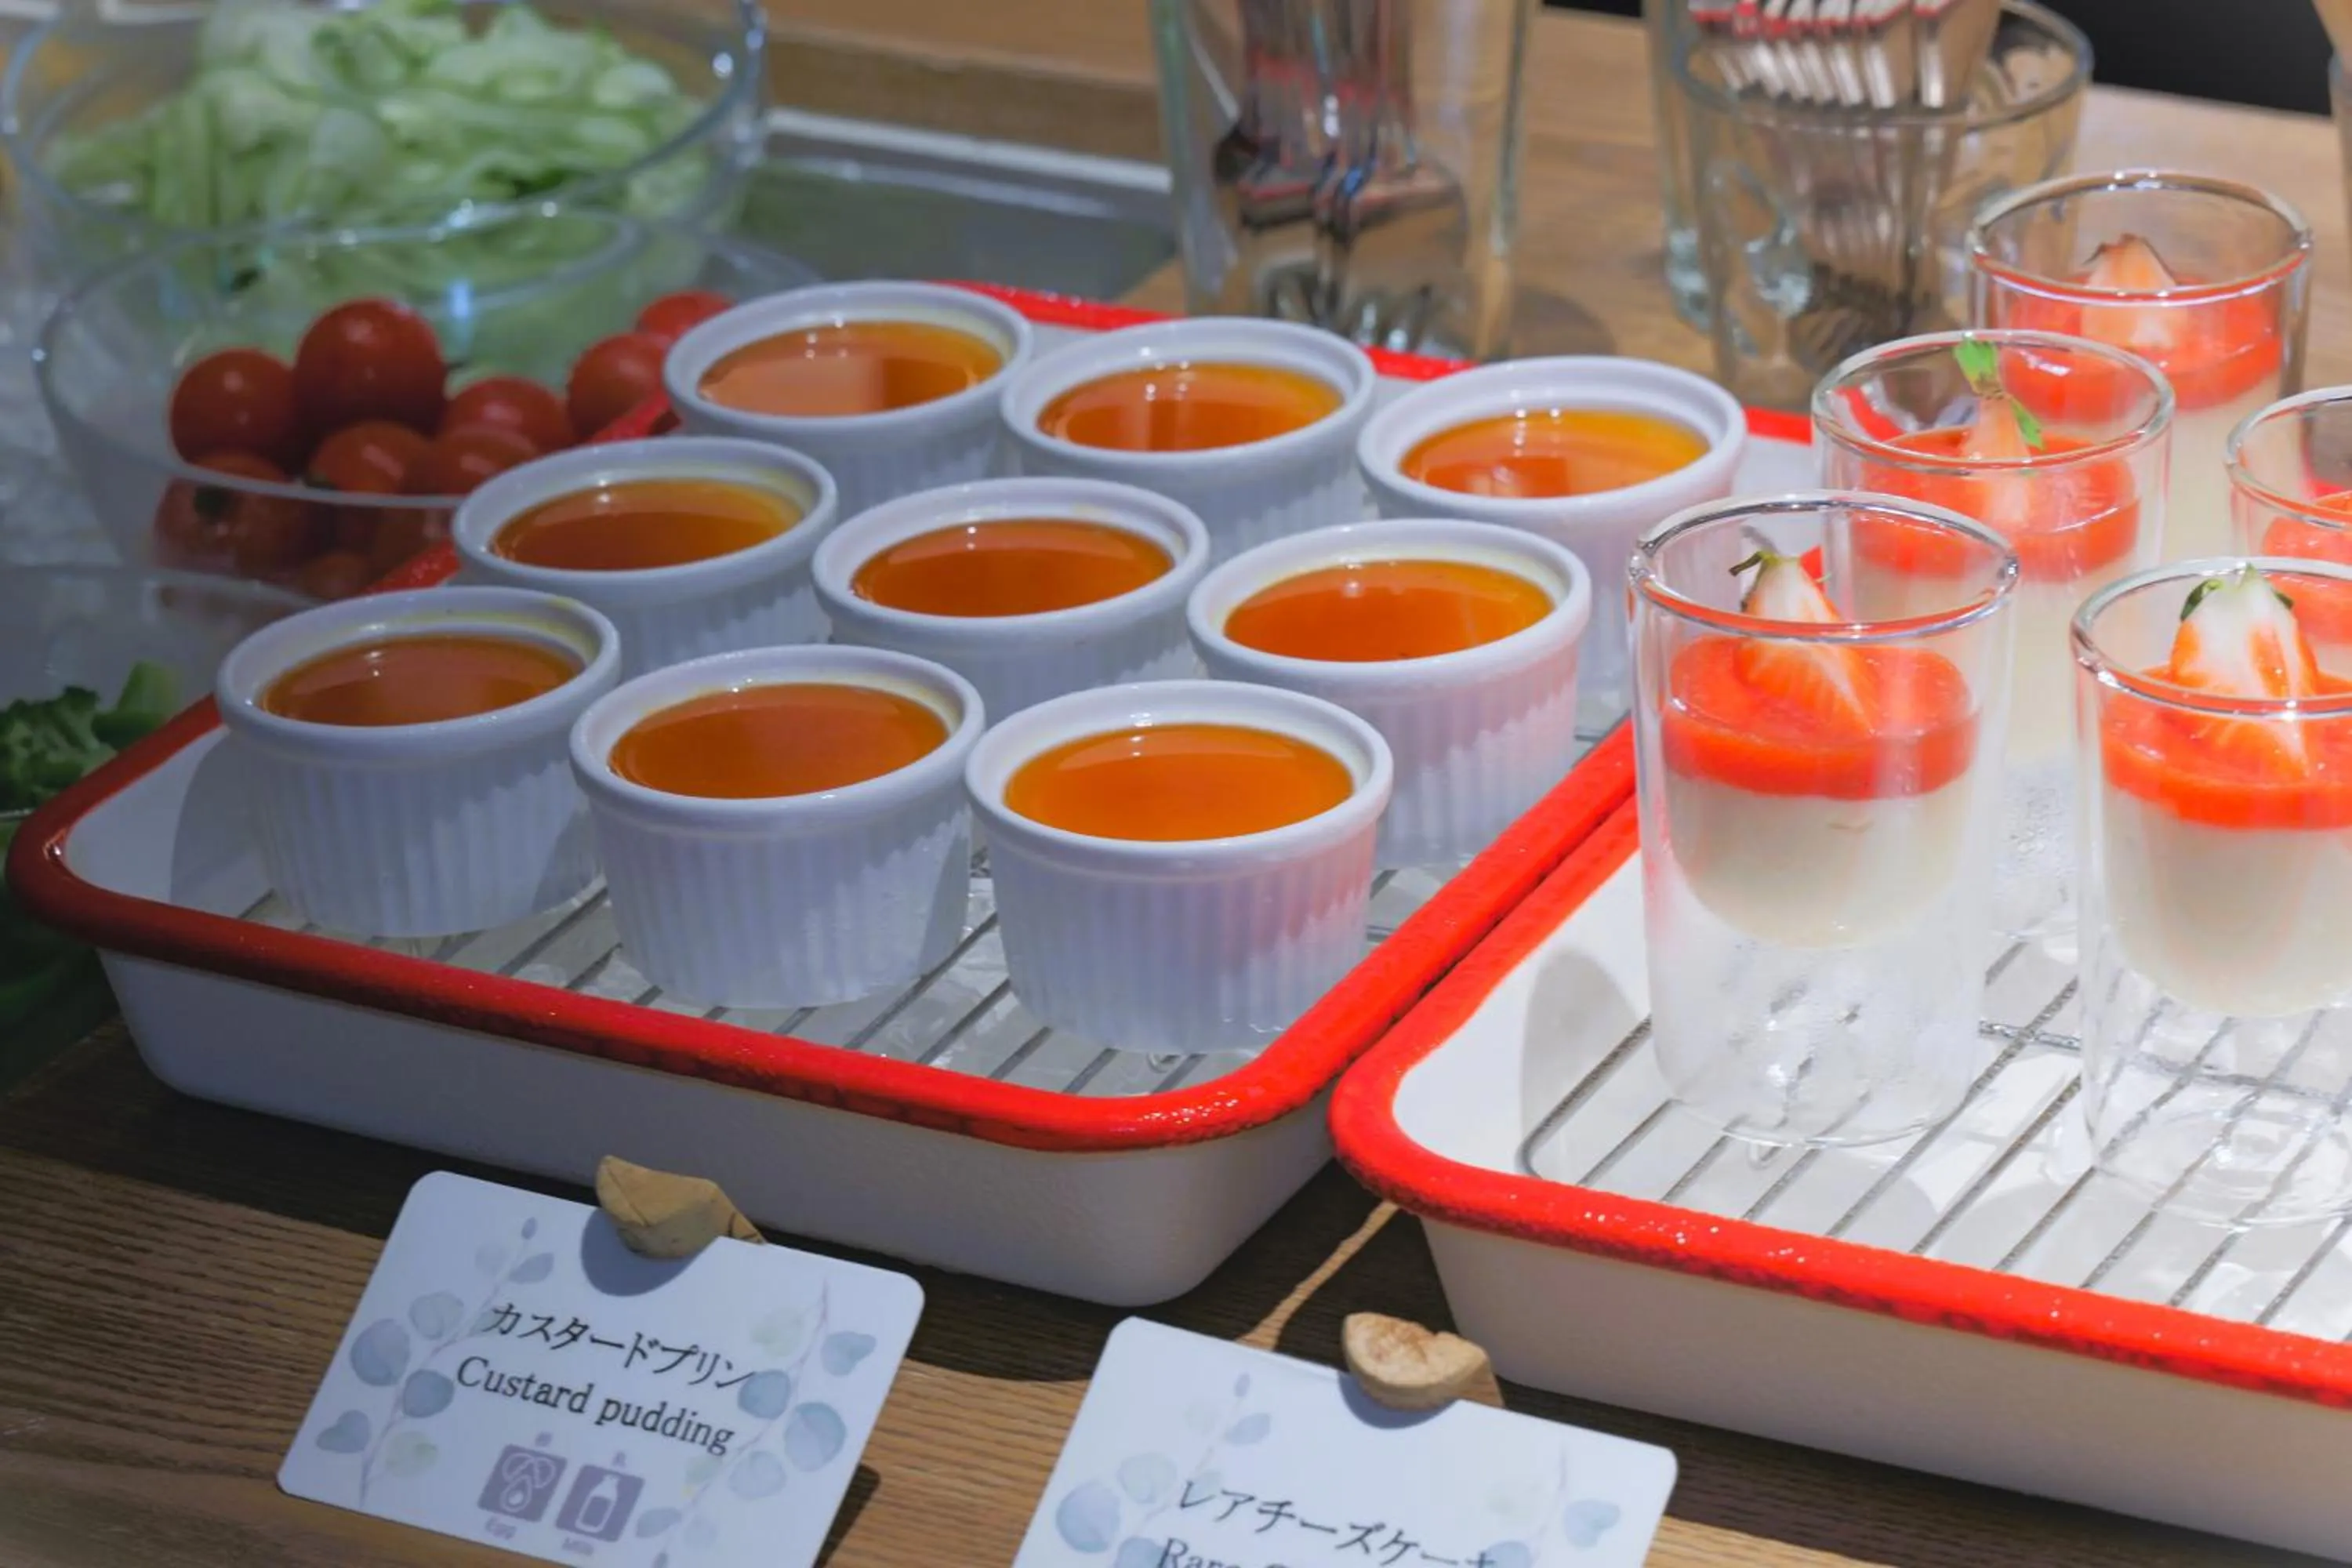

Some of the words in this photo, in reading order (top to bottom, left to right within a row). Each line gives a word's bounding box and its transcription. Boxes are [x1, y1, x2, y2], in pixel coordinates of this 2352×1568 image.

[481, 1302, 757, 1388] カスタードプリン
[457, 1356, 595, 1414] Custard
[593, 1401, 735, 1457] pudding
